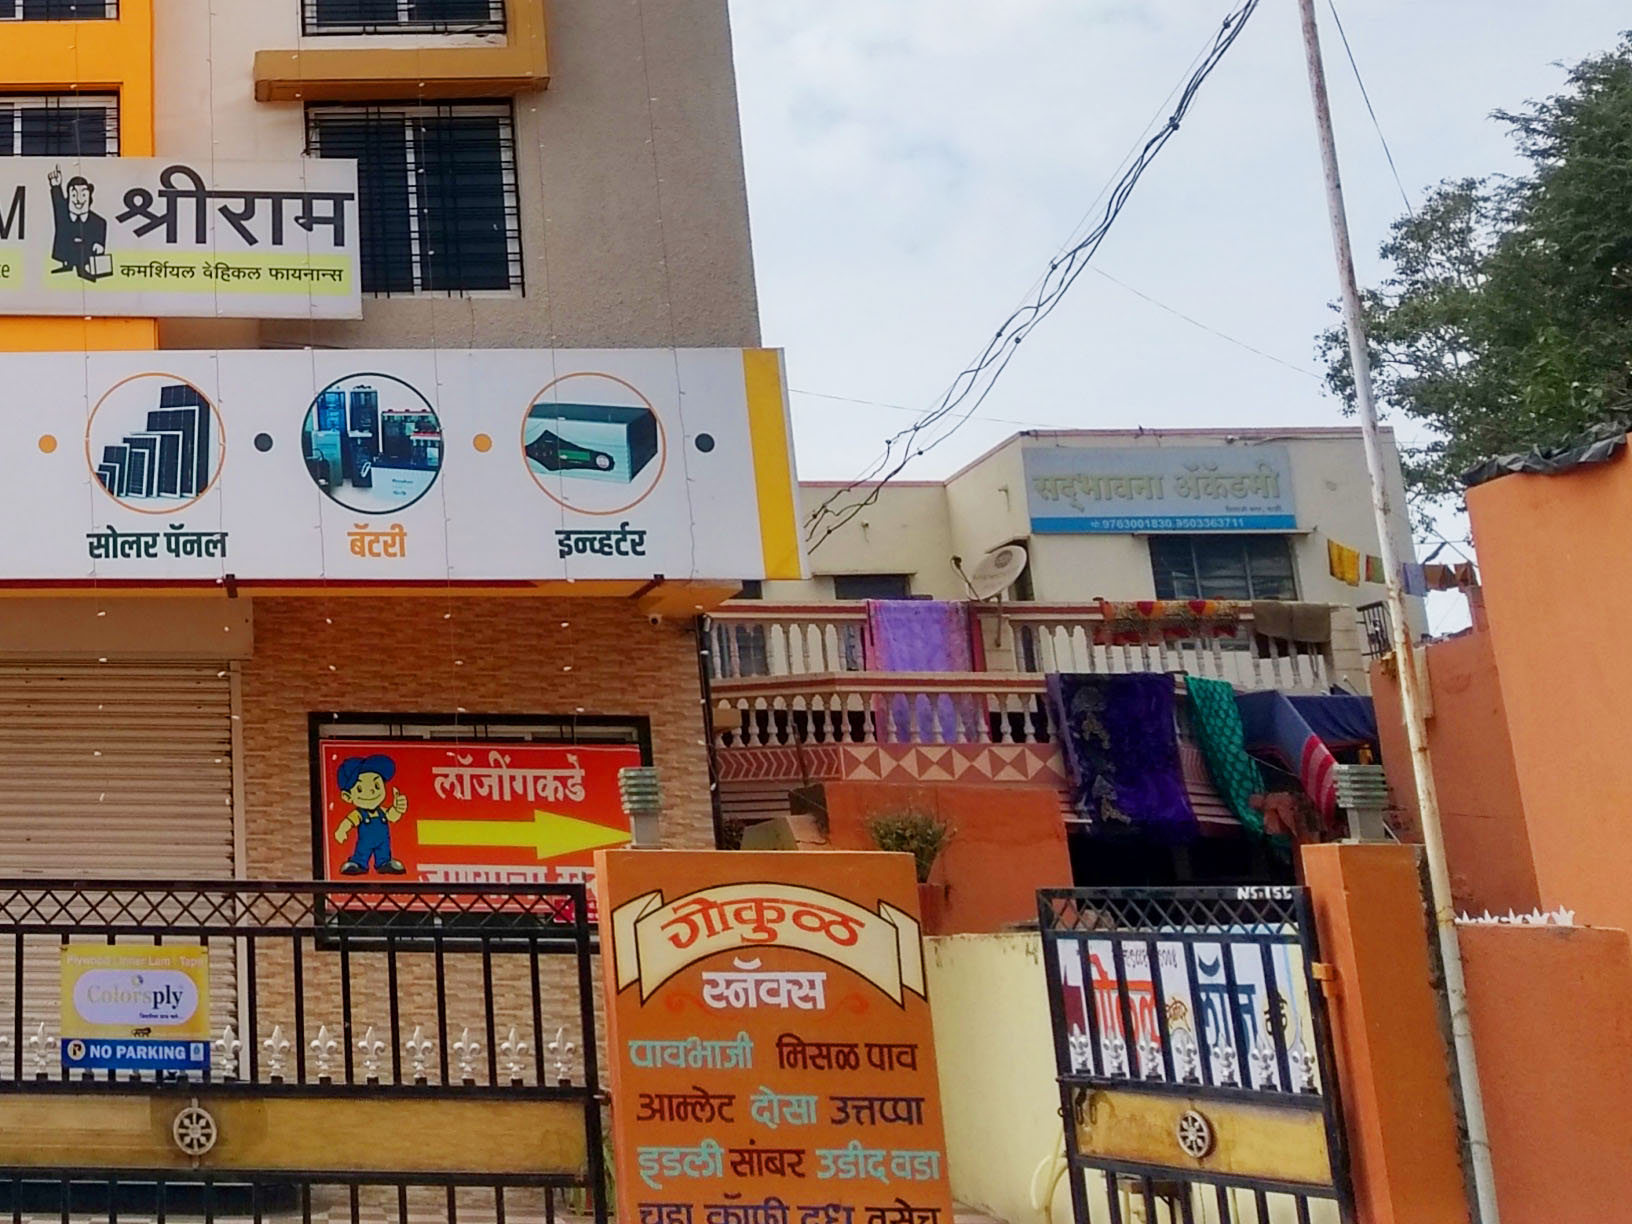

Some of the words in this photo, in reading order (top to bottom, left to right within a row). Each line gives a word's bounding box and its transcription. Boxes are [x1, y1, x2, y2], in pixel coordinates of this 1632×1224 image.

[116, 164, 355, 248] श्रीराम
[119, 260, 196, 279] कमर्शियल
[268, 266, 344, 282] फायनान्स
[86, 524, 159, 560] सोलर
[164, 523, 229, 560] पॅनल
[347, 522, 407, 559] बॅटरी
[660, 896, 866, 950] गोकुळ
[86, 984, 184, 1010] Colorsply
[701, 956, 827, 1010] स्नॅक्स
[89, 1044, 112, 1060] NO
[116, 1044, 187, 1061] PARKING
[628, 1031, 754, 1069] पावभाजी
[776, 1032, 860, 1071] मिसळ
[865, 1042, 918, 1071] पाव
[635, 1086, 736, 1123] आम्लेट
[749, 1085, 819, 1129] दोसा
[637, 1137, 724, 1191] इडली
[729, 1139, 806, 1178] सांबर
[890, 1149, 941, 1181] वडा
